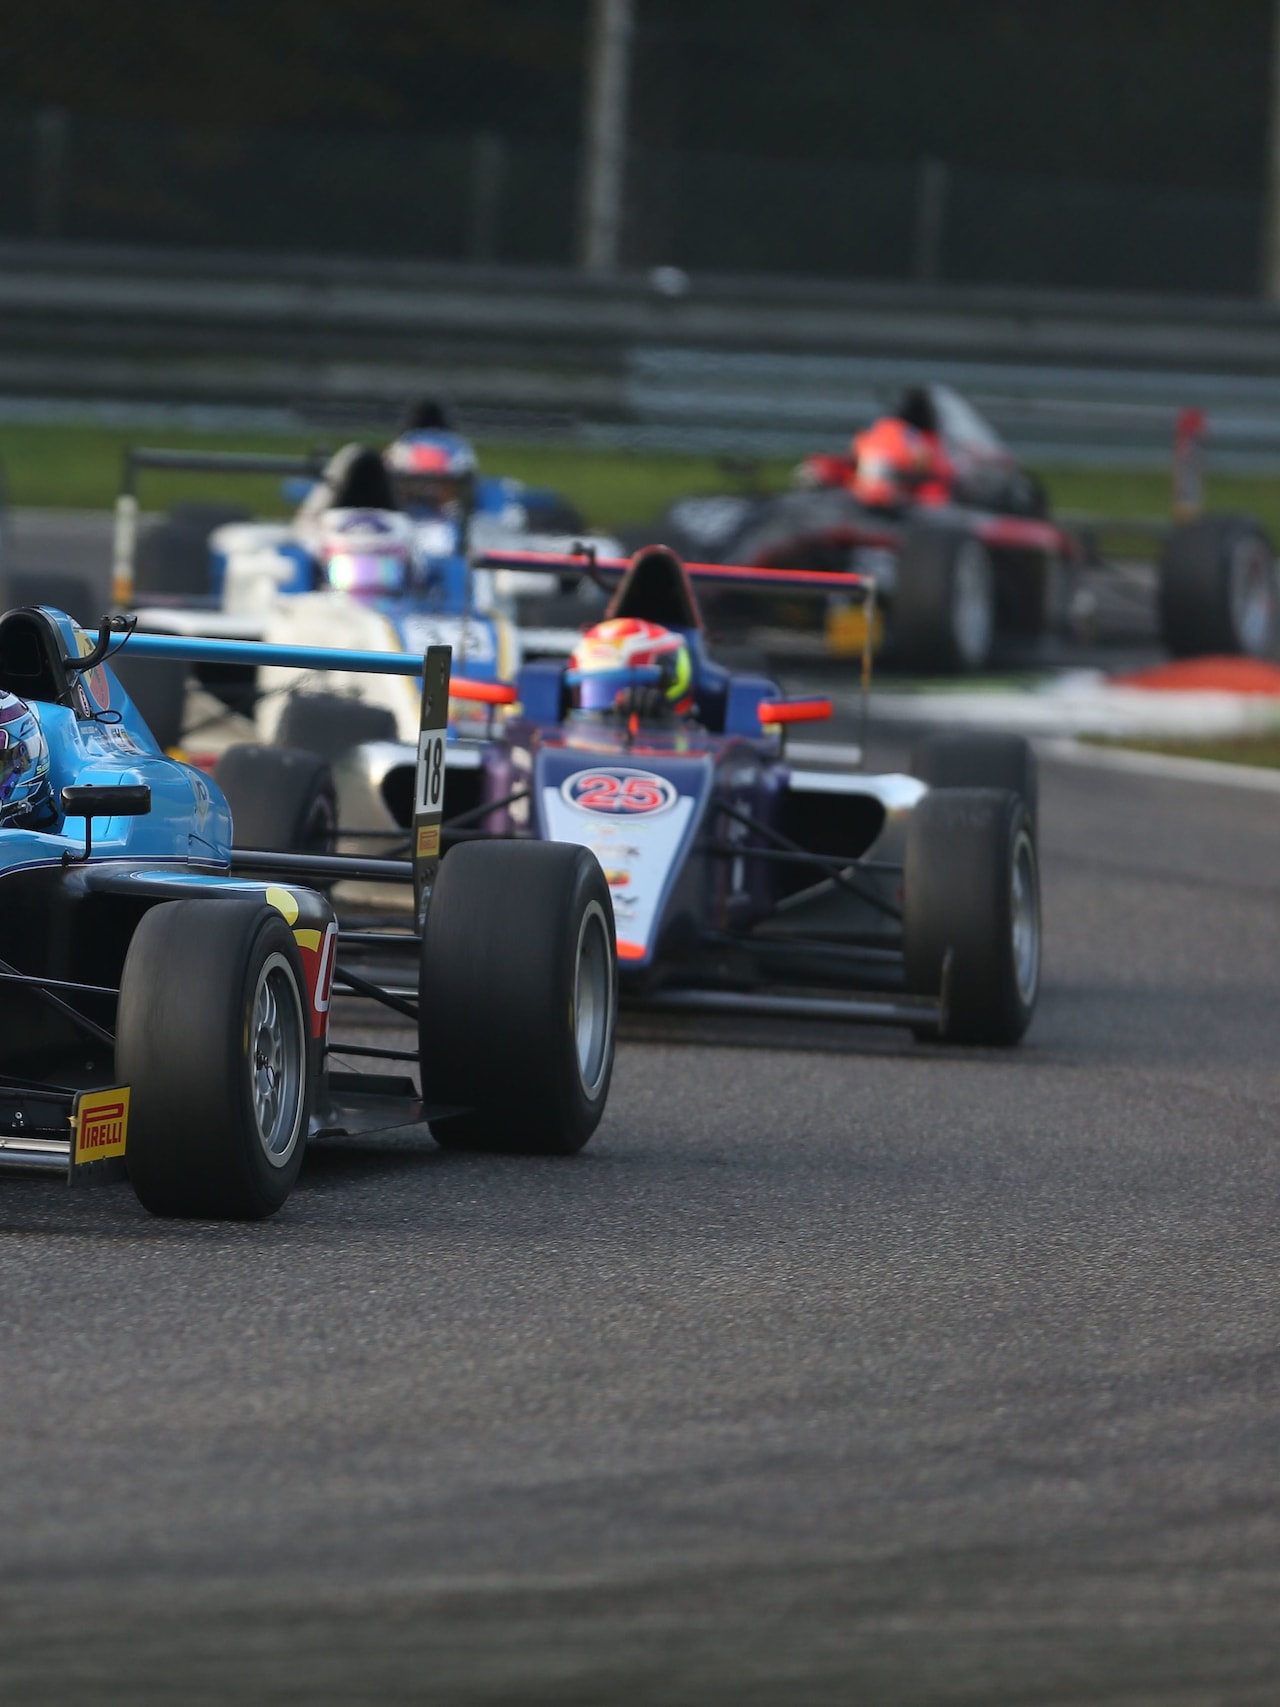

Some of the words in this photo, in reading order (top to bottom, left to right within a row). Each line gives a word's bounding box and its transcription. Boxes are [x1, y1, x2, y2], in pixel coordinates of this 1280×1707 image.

[423, 738, 442, 805] 18
[578, 775, 664, 812] 25
[80, 1103, 124, 1149] PIRELLI
